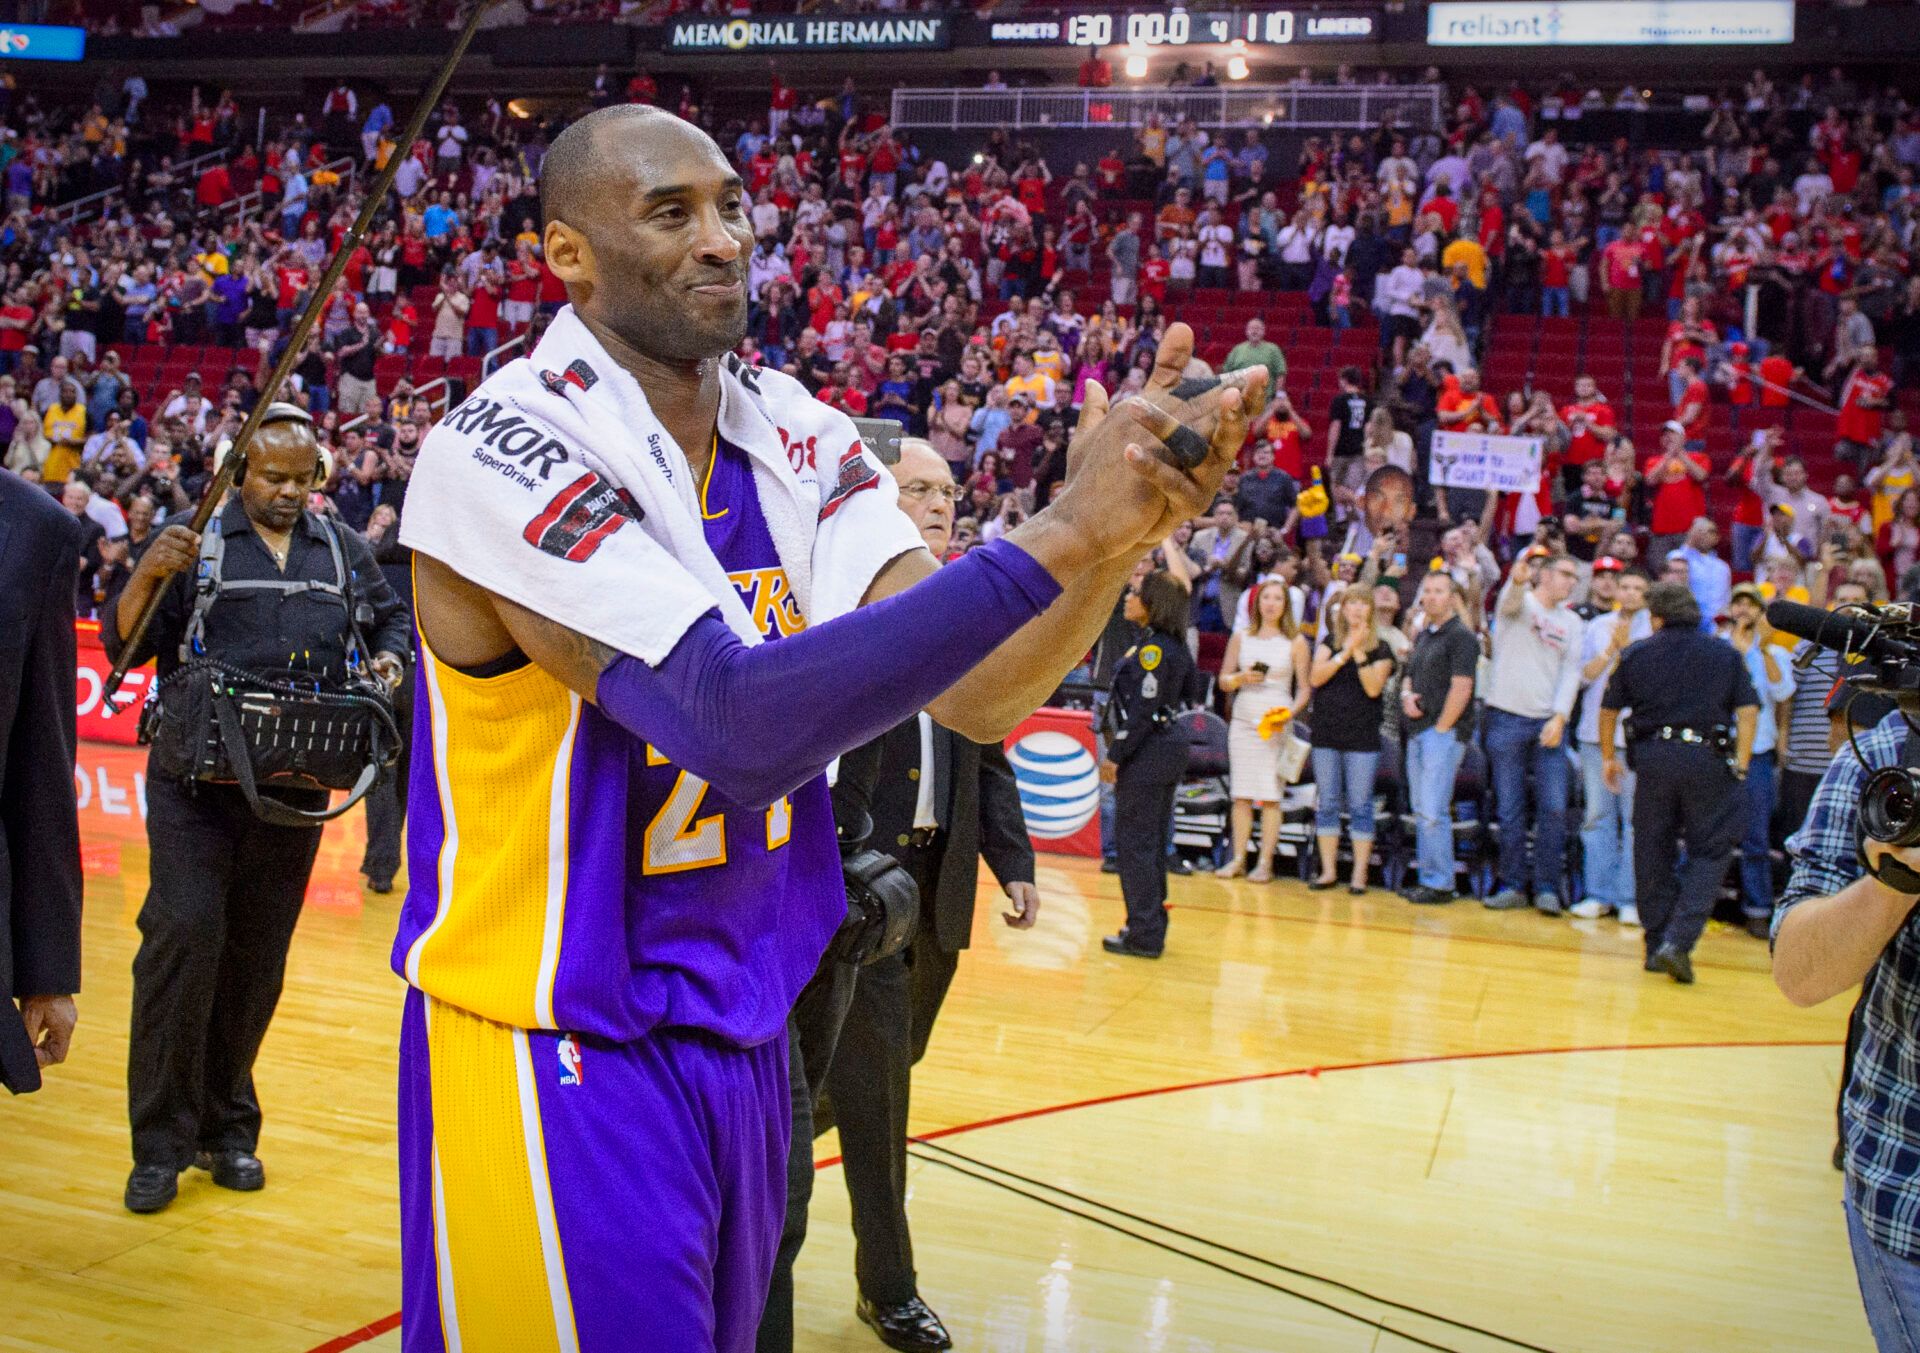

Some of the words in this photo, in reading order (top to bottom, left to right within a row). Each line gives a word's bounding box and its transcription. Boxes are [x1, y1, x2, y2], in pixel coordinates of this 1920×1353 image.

[672, 20, 798, 49] MEMORIAL
[806, 20, 941, 43] HERMANN
[1068, 14, 1112, 46] 130
[1127, 13, 1189, 45] 00.0
[1210, 20, 1229, 43] 4
[1448, 13, 1542, 36] reliant
[560, 1075, 577, 1085] NBA
